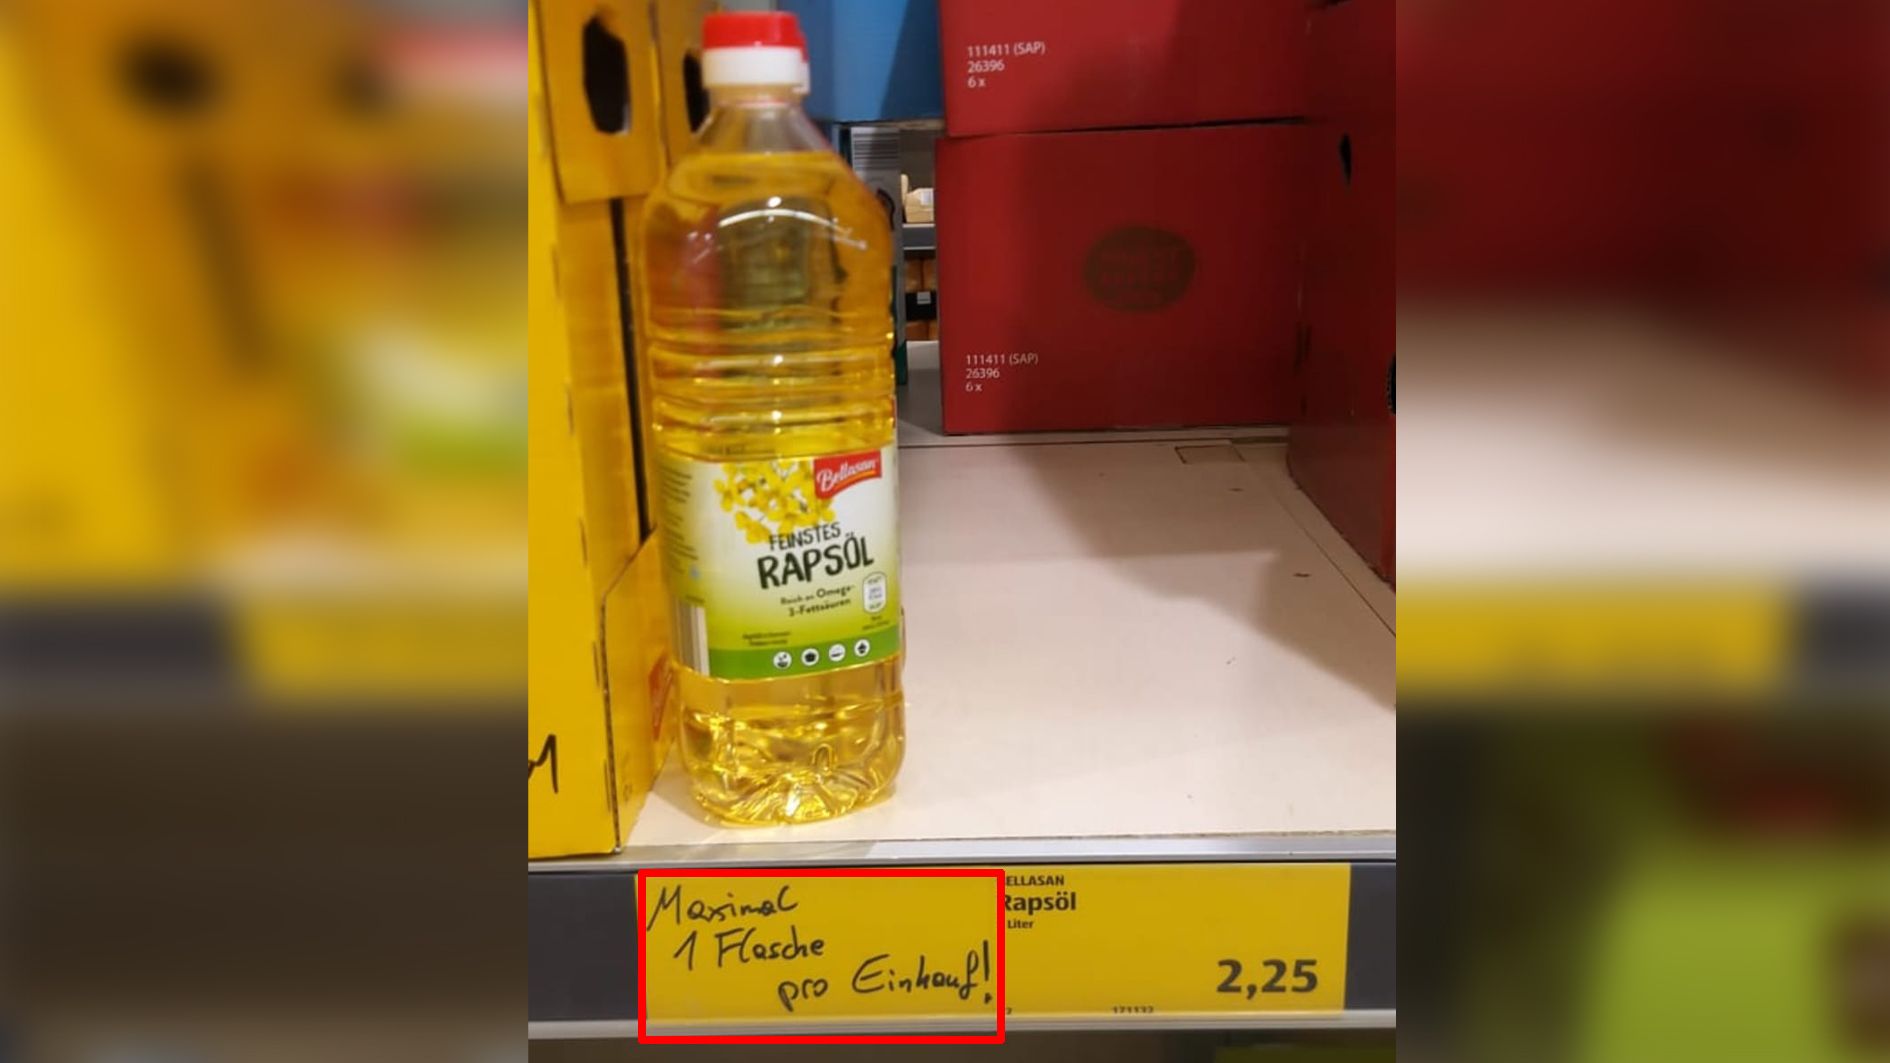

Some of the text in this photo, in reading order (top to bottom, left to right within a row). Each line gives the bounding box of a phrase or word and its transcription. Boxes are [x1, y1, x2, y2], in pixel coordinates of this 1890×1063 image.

[967, 41, 1046, 57] 111411 (SAP)
[967, 59, 1005, 73] 26396
[967, 76, 986, 88] 6 x
[965, 353, 1039, 366] 111411 (SAP)
[965, 368, 1000, 379] 26396
[965, 381, 983, 392] 6 x
[816, 460, 876, 492] Bellasan
[769, 521, 841, 551] FEINSTES
[757, 532, 874, 589] RAPSÖL
[1005, 875, 1065, 887] ELLASAN
[646, 885, 798, 931] Maximal
[1007, 919, 1034, 929] Liter
[673, 925, 825, 971] 1 Flasche
[777, 939, 993, 1012] pro Einkauf!
[1216, 958, 1319, 1000] 2,25
